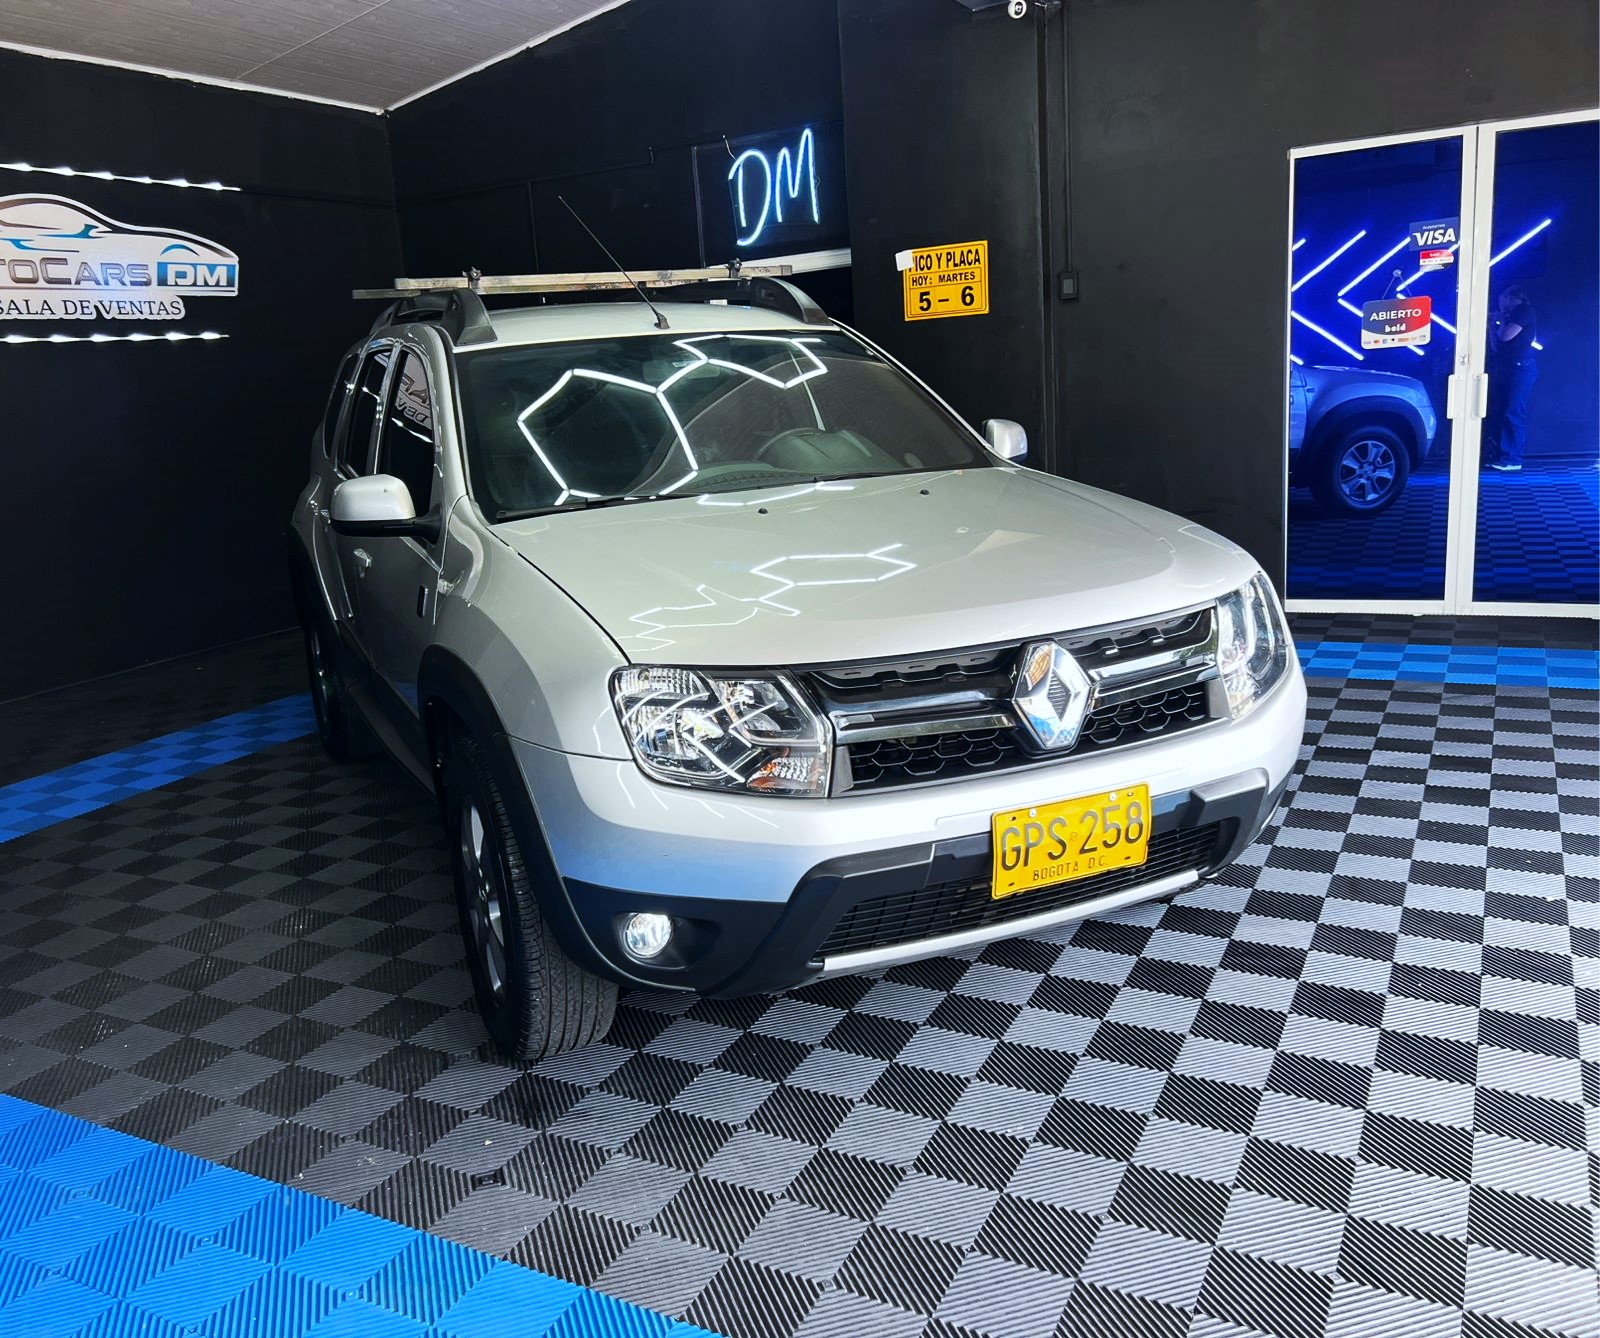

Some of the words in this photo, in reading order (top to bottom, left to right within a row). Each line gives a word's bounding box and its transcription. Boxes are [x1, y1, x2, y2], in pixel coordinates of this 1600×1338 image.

[727, 128, 819, 246] DM
[1412, 228, 1456, 247] VISA
[908, 253, 933, 272] ICO
[936, 252, 943, 270] Y
[946, 248, 981, 269] PLACA
[166, 263, 228, 287] DM
[911, 275, 933, 287] HOY:
[938, 271, 976, 283] MARTES
[61, 299, 94, 316] DE
[98, 300, 183, 316] VENTAS
[919, 291, 932, 312] 5
[961, 285, 975, 307] 6
[1369, 308, 1423, 322] ABIERTO
[1384, 323, 1407, 333] bold
[1001, 816, 1068, 872] GPS
[1078, 801, 1145, 855] 258
[1032, 860, 1080, 882] BOGOTA
